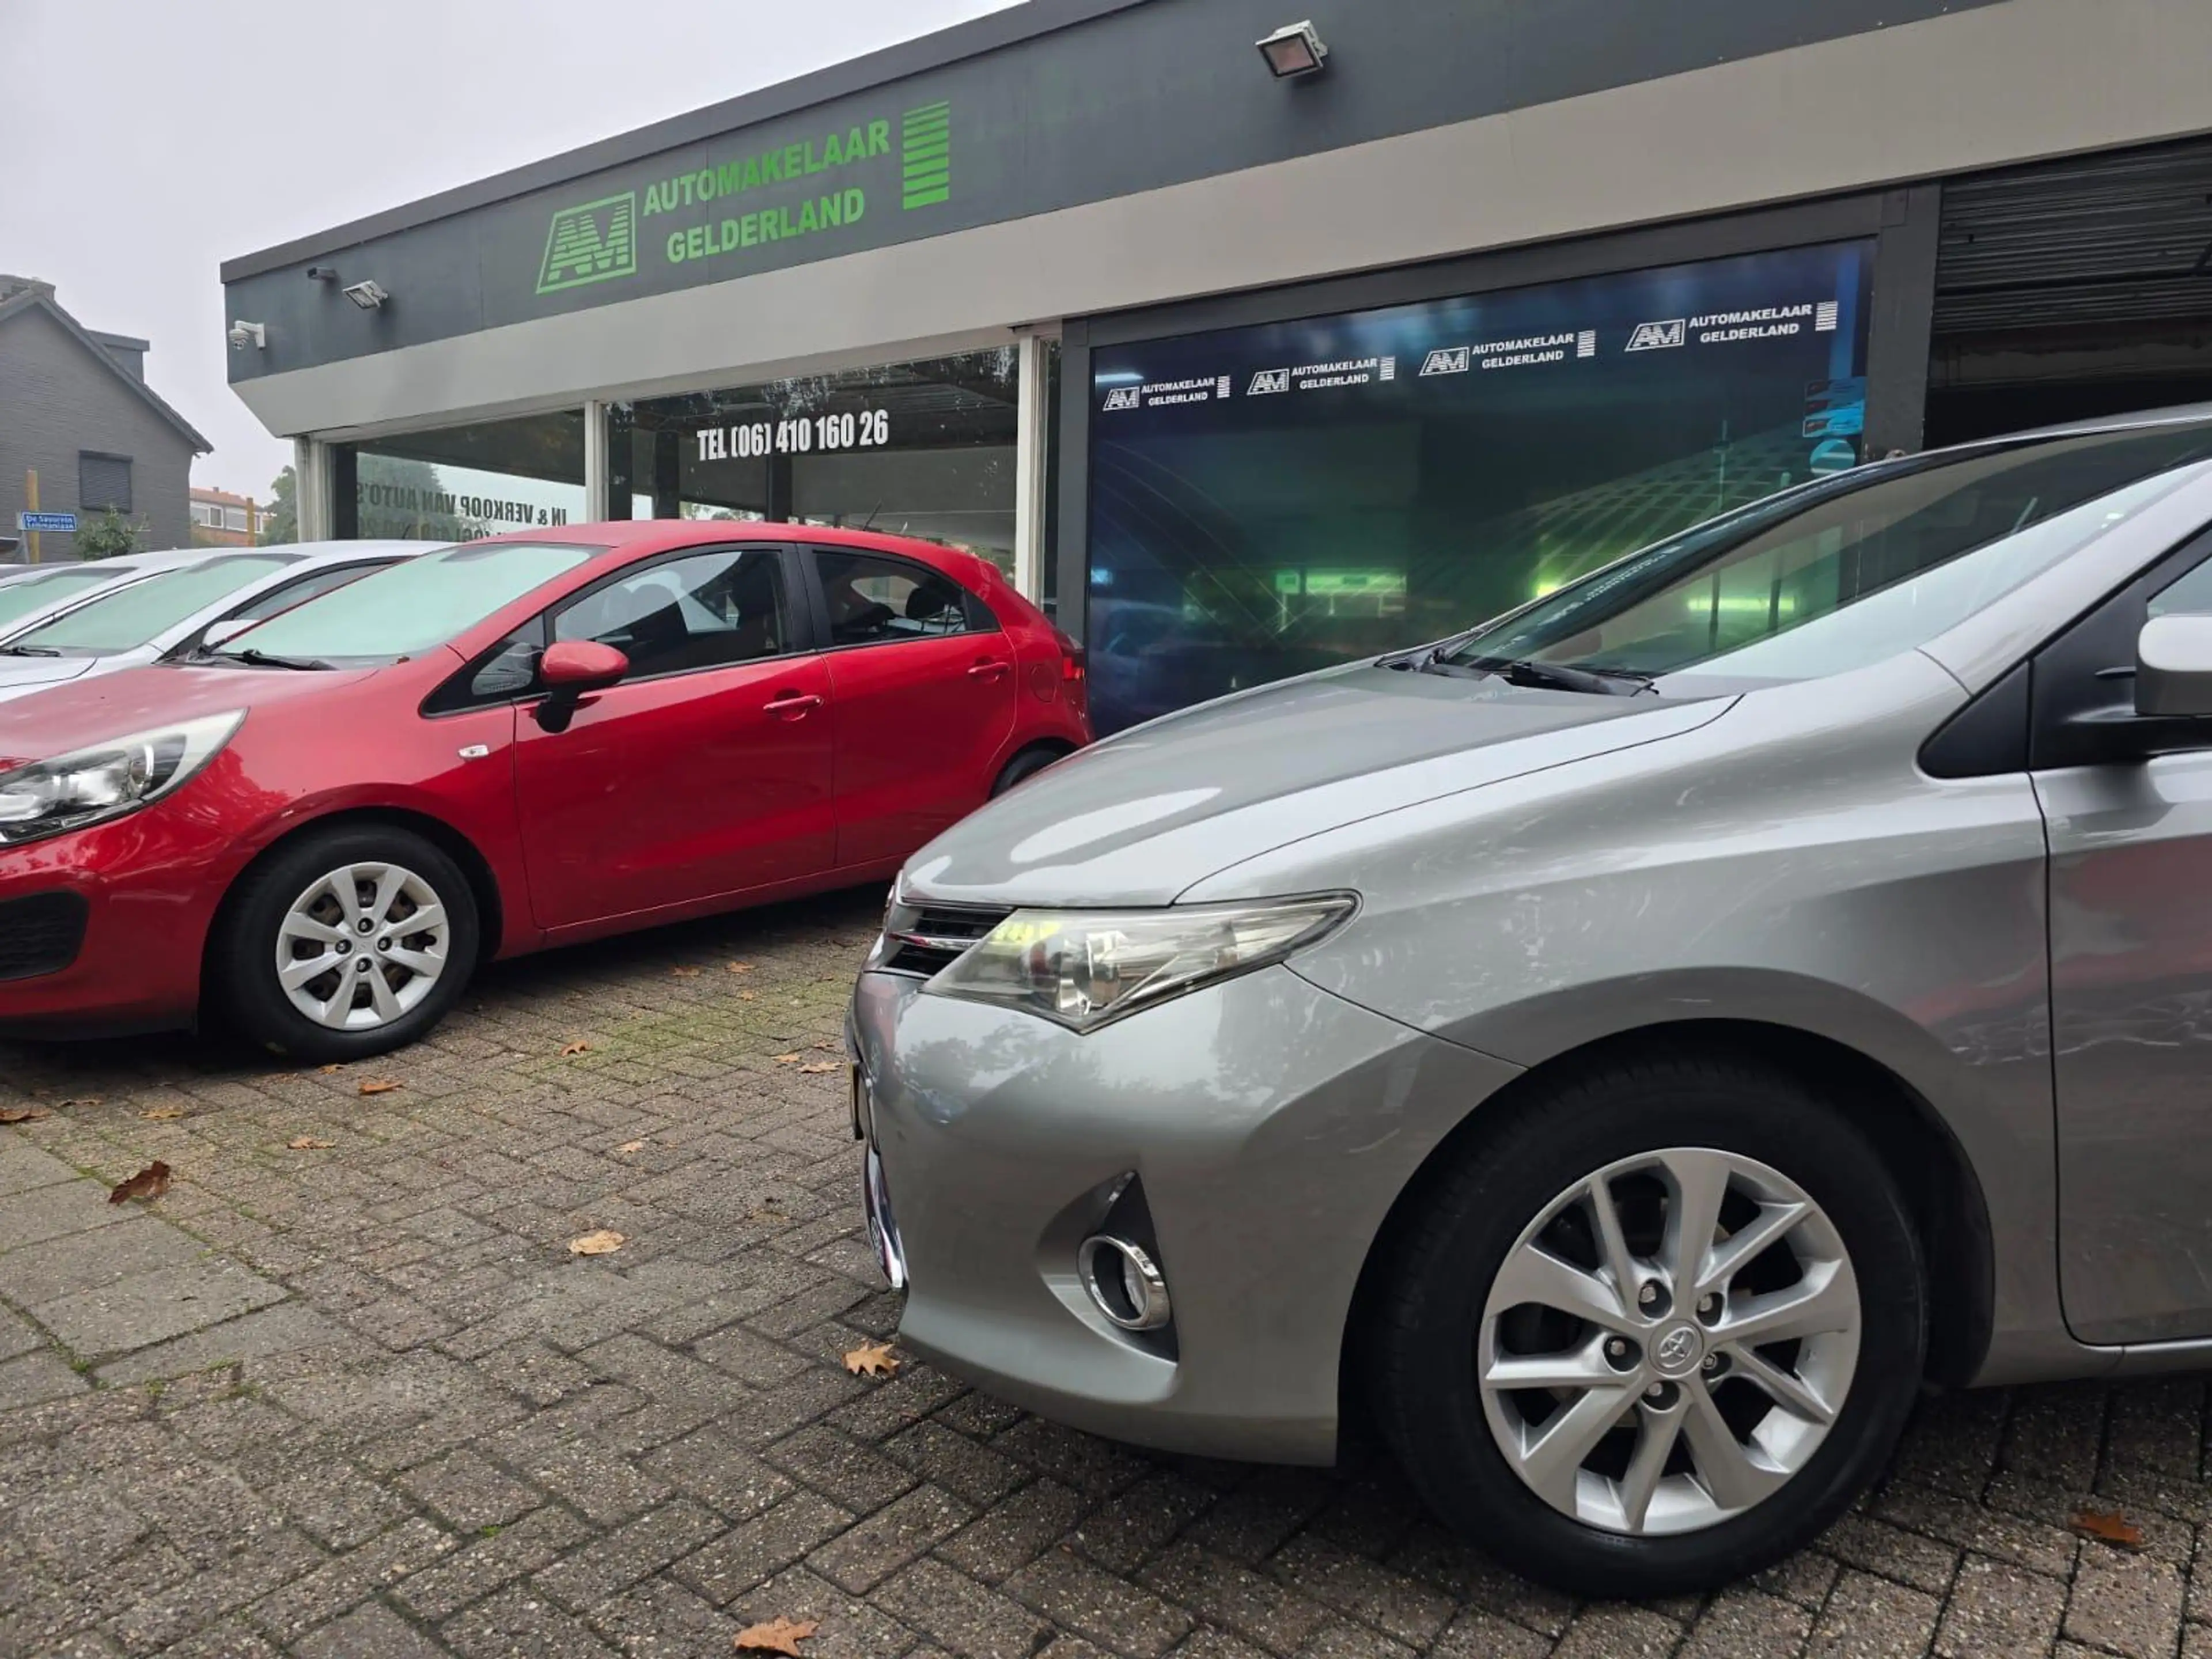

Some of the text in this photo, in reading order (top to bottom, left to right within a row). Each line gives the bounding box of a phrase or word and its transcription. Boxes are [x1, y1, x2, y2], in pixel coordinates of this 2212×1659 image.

[643, 119, 891, 216] AUTOMAKELAAR
[666, 188, 865, 263] GELDERLAND
[1689, 304, 1812, 328] AUTOMAKELAAR
[1700, 323, 1799, 343] GELDERLAND
[1472, 332, 1574, 355] AUTOMAKELAAR
[1291, 358, 1377, 376] AUTOMAKELAAR
[1482, 350, 1564, 369] GELDERLAND
[1141, 377, 1215, 393] AUTOMAKELAAR
[1300, 374, 1369, 390] GELDERLAND
[1149, 392, 1208, 406] GELDERLAND
[696, 409, 889, 461] TEL (06) 410 160 26
